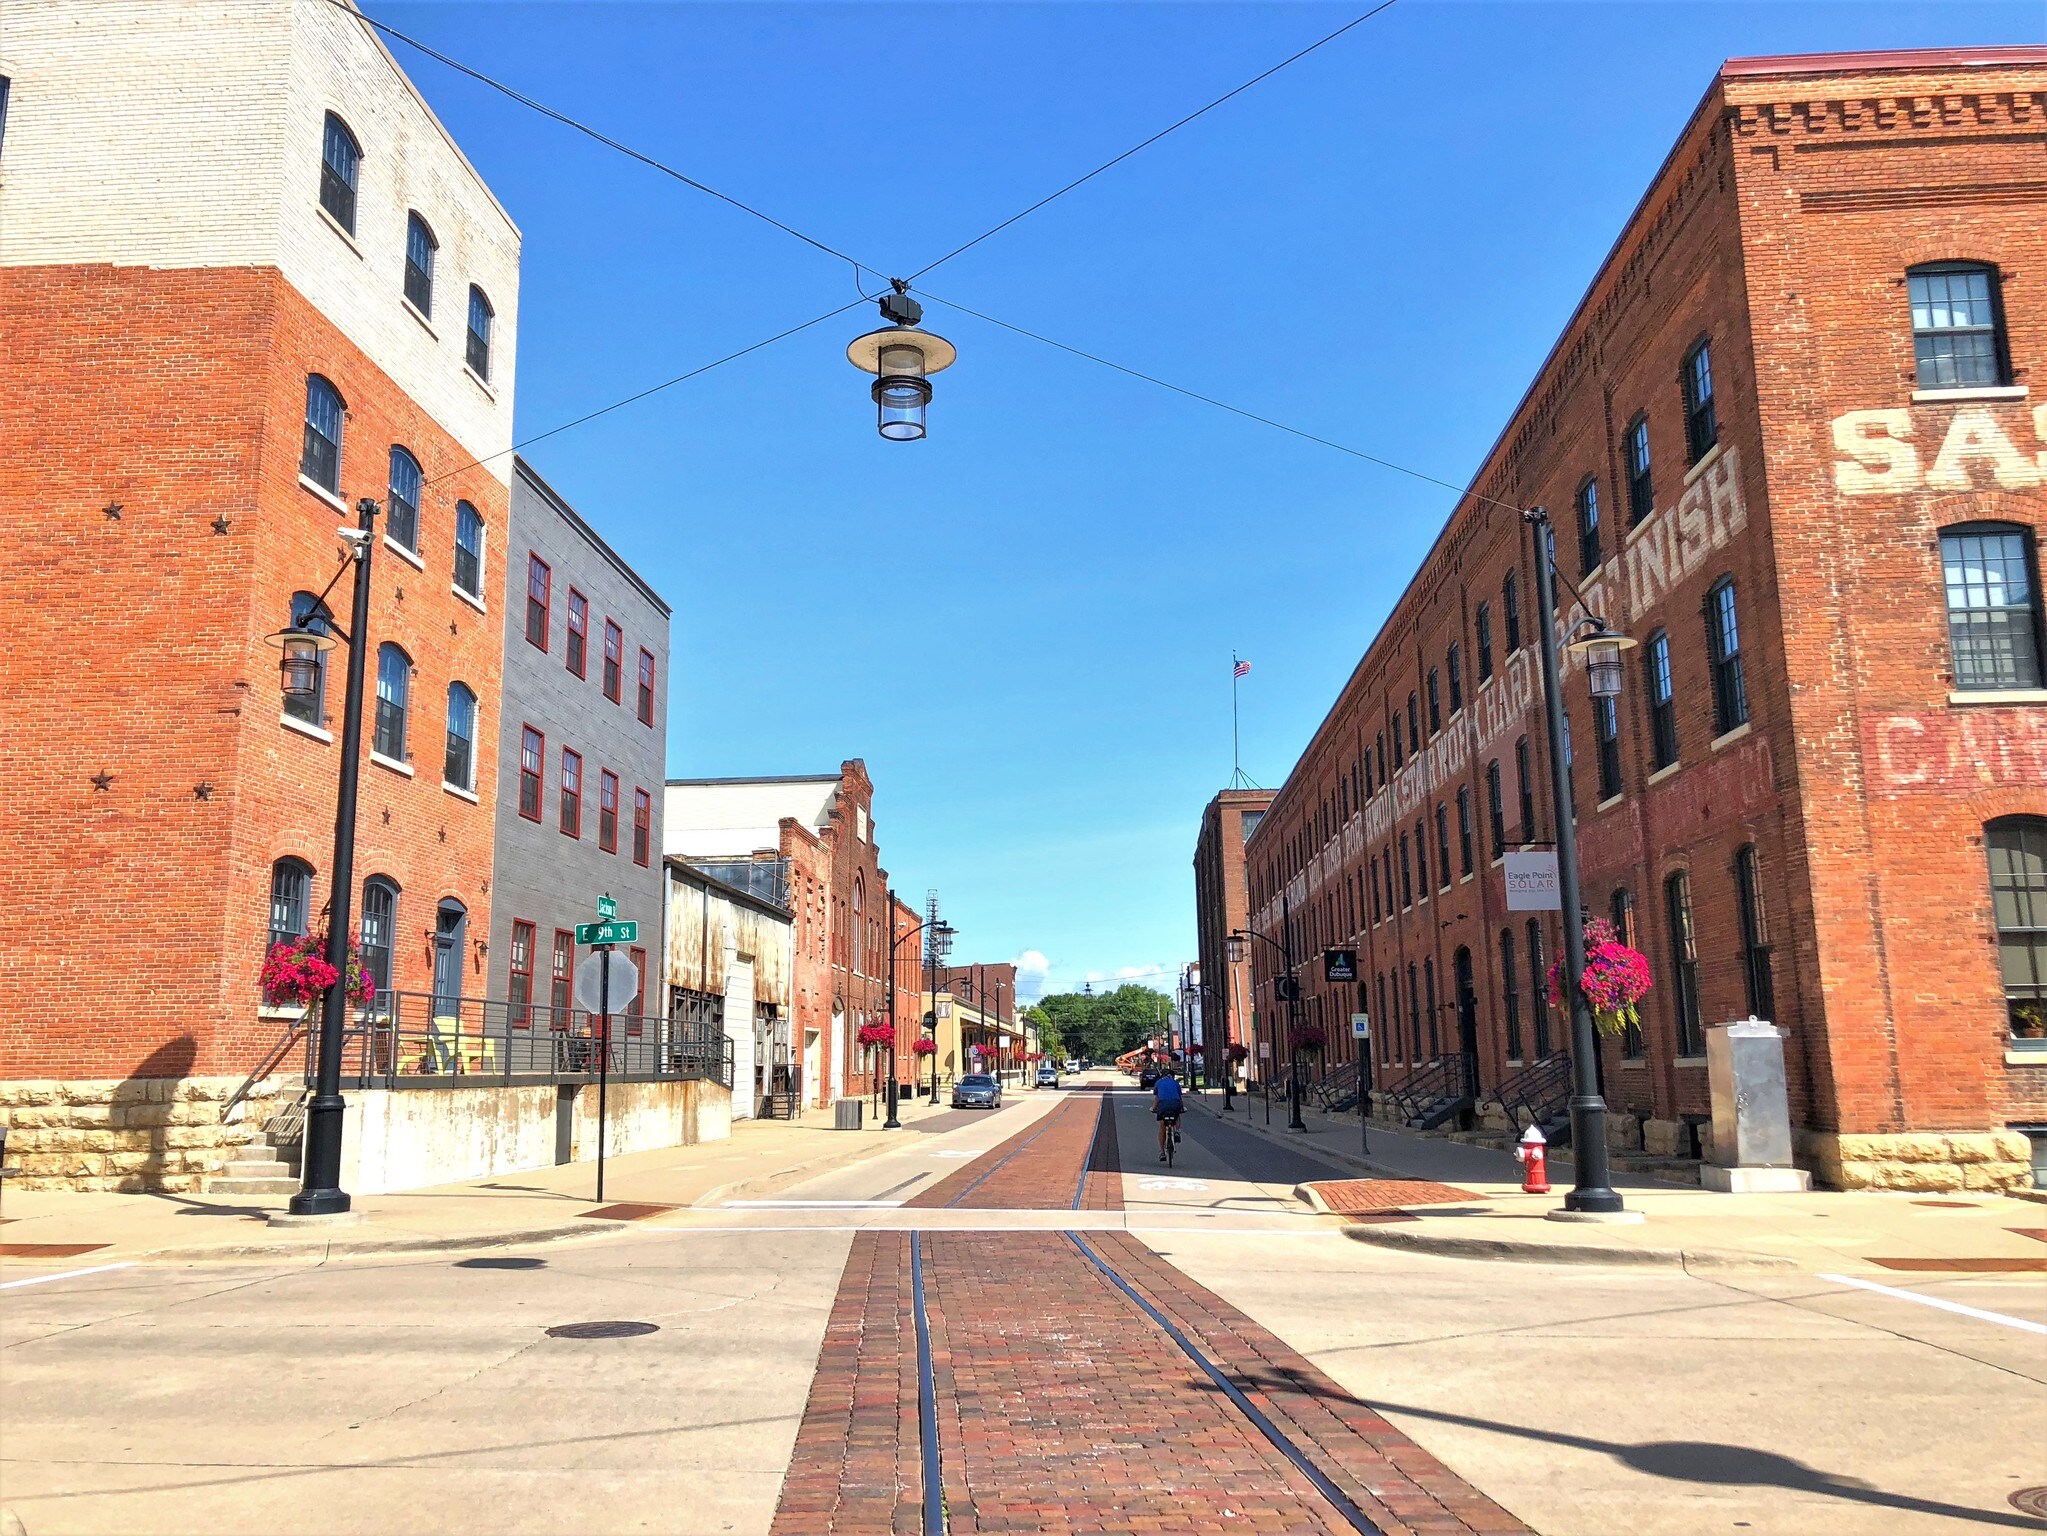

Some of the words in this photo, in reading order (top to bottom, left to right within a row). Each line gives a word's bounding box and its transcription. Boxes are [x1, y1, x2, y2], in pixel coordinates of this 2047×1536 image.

[1832, 406, 2047, 496] SA
[1508, 872, 1530, 880] Eagle
[1532, 871, 1553, 879] Point
[1509, 879, 1554, 889] SOLAR
[582, 927, 588, 941] E
[597, 926, 613, 940] 9th
[620, 926, 630, 939] St
